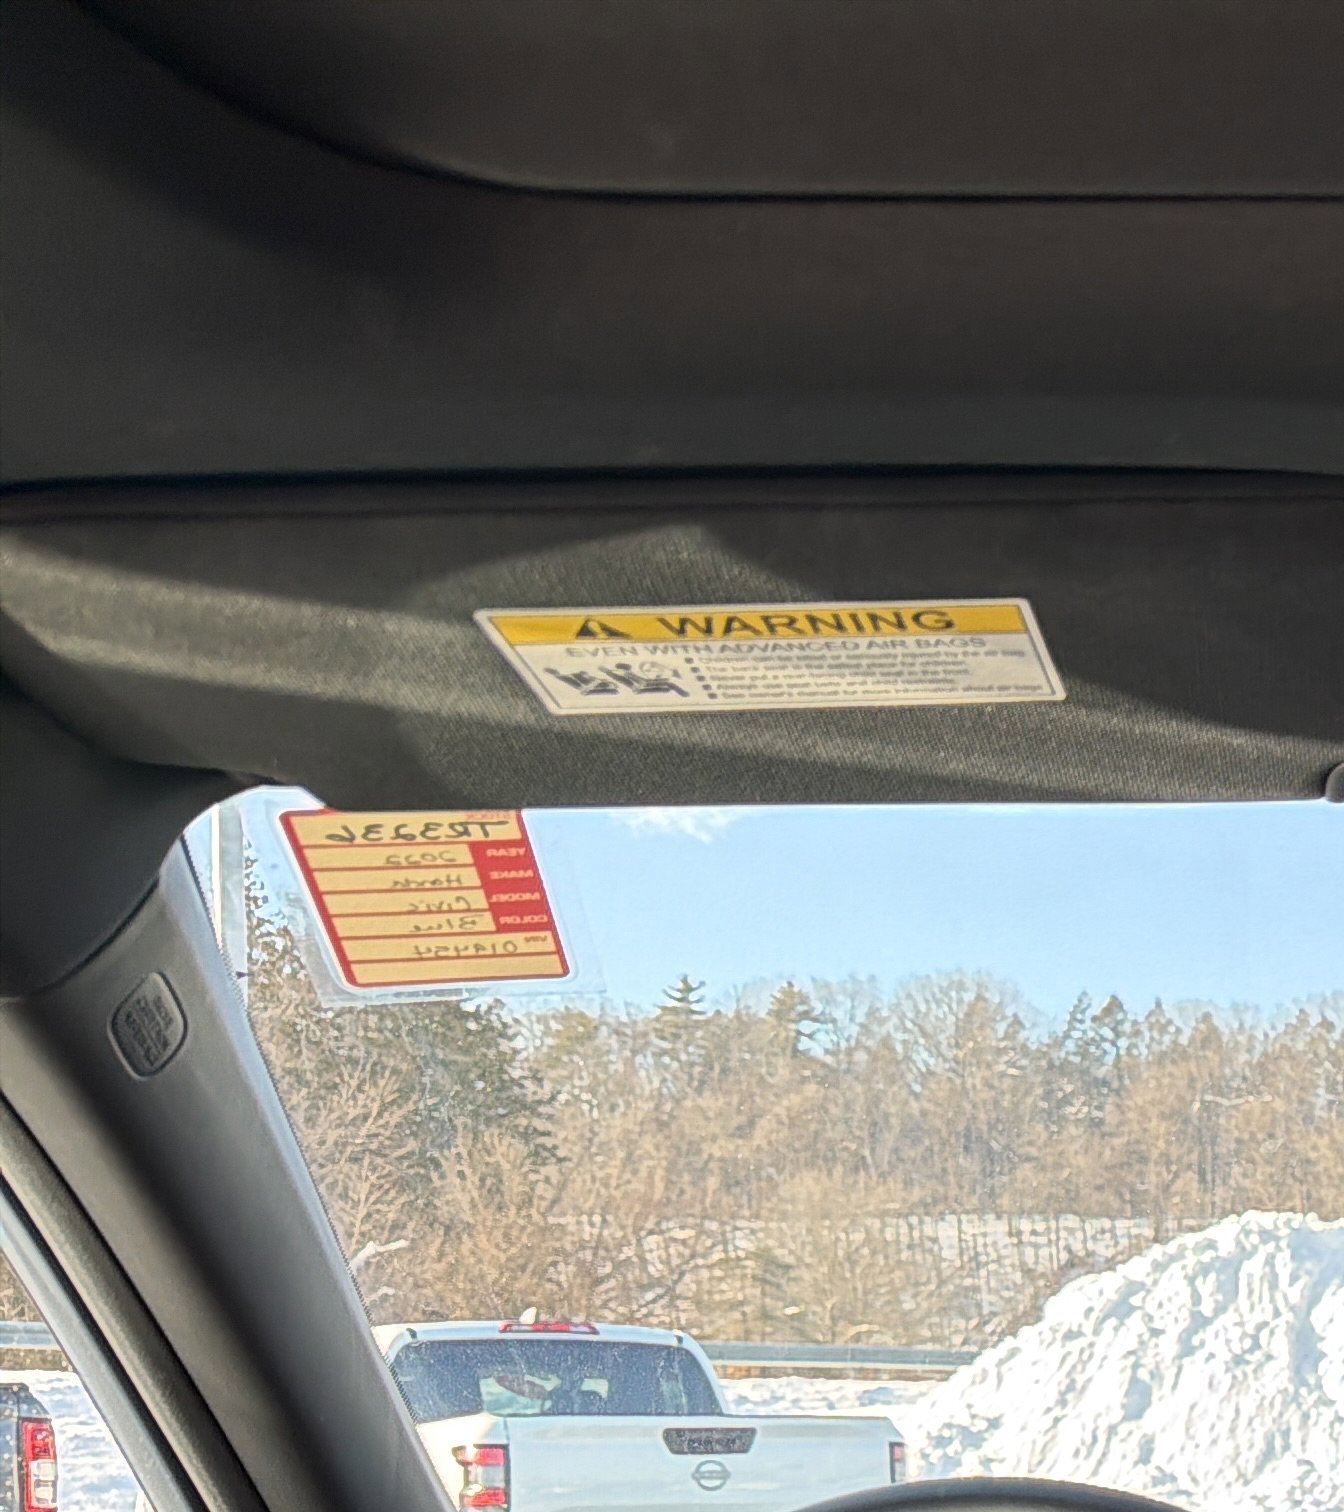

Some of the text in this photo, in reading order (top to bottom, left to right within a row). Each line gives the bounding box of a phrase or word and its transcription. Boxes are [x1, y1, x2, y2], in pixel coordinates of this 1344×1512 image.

[657, 609, 956, 638] WARNING
[565, 637, 987, 658] EVEN WITH ADVANCED AIR BAGS
